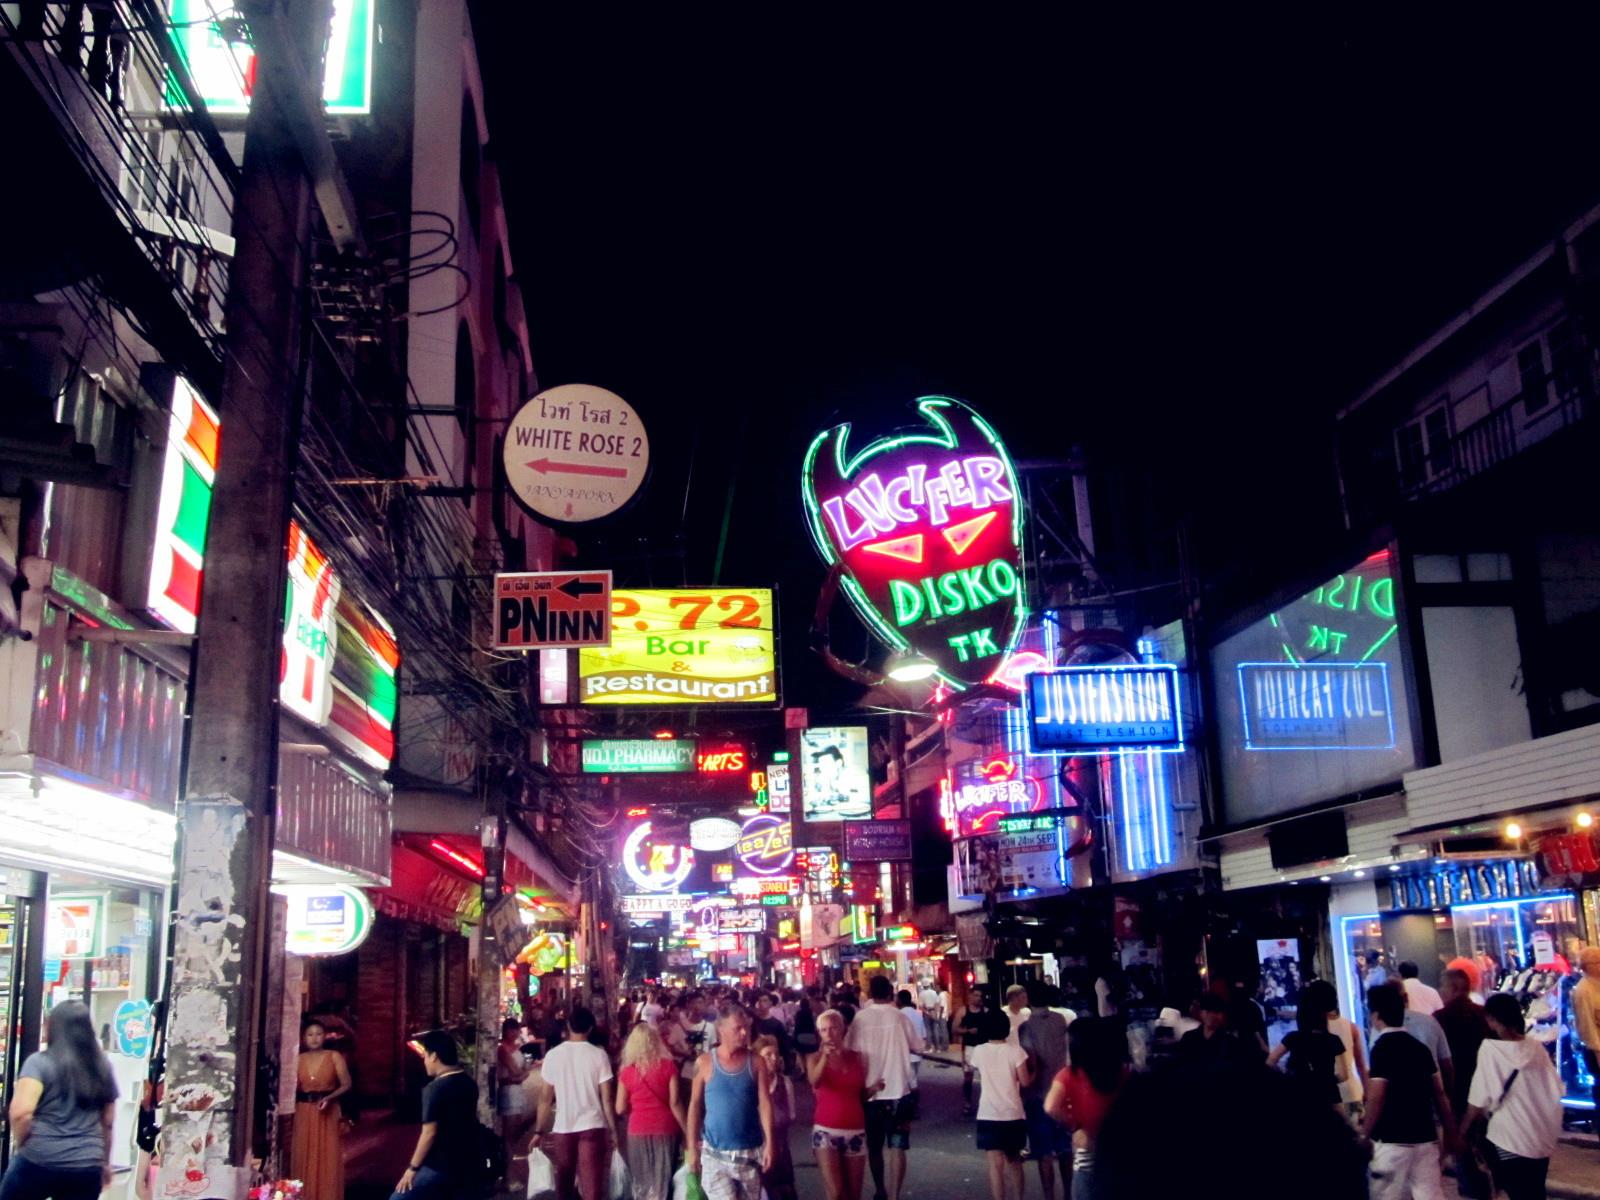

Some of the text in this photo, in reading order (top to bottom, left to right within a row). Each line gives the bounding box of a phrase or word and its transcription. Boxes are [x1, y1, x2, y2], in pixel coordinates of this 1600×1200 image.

[537, 398, 628, 425] ไวท์ โรส 2
[516, 426, 642, 457] WHITE ROSE 2
[822, 457, 1013, 552] LUCIFER
[889, 558, 1016, 626] DISKO
[646, 636, 711, 656] Bar
[948, 627, 1000, 662] TK
[671, 660, 692, 672] &
[587, 673, 770, 699] Restaurant
[1095, 726, 1169, 739] FASHION
[615, 749, 695, 765] PHARMACY
[1037, 832, 1056, 844] SEPT
